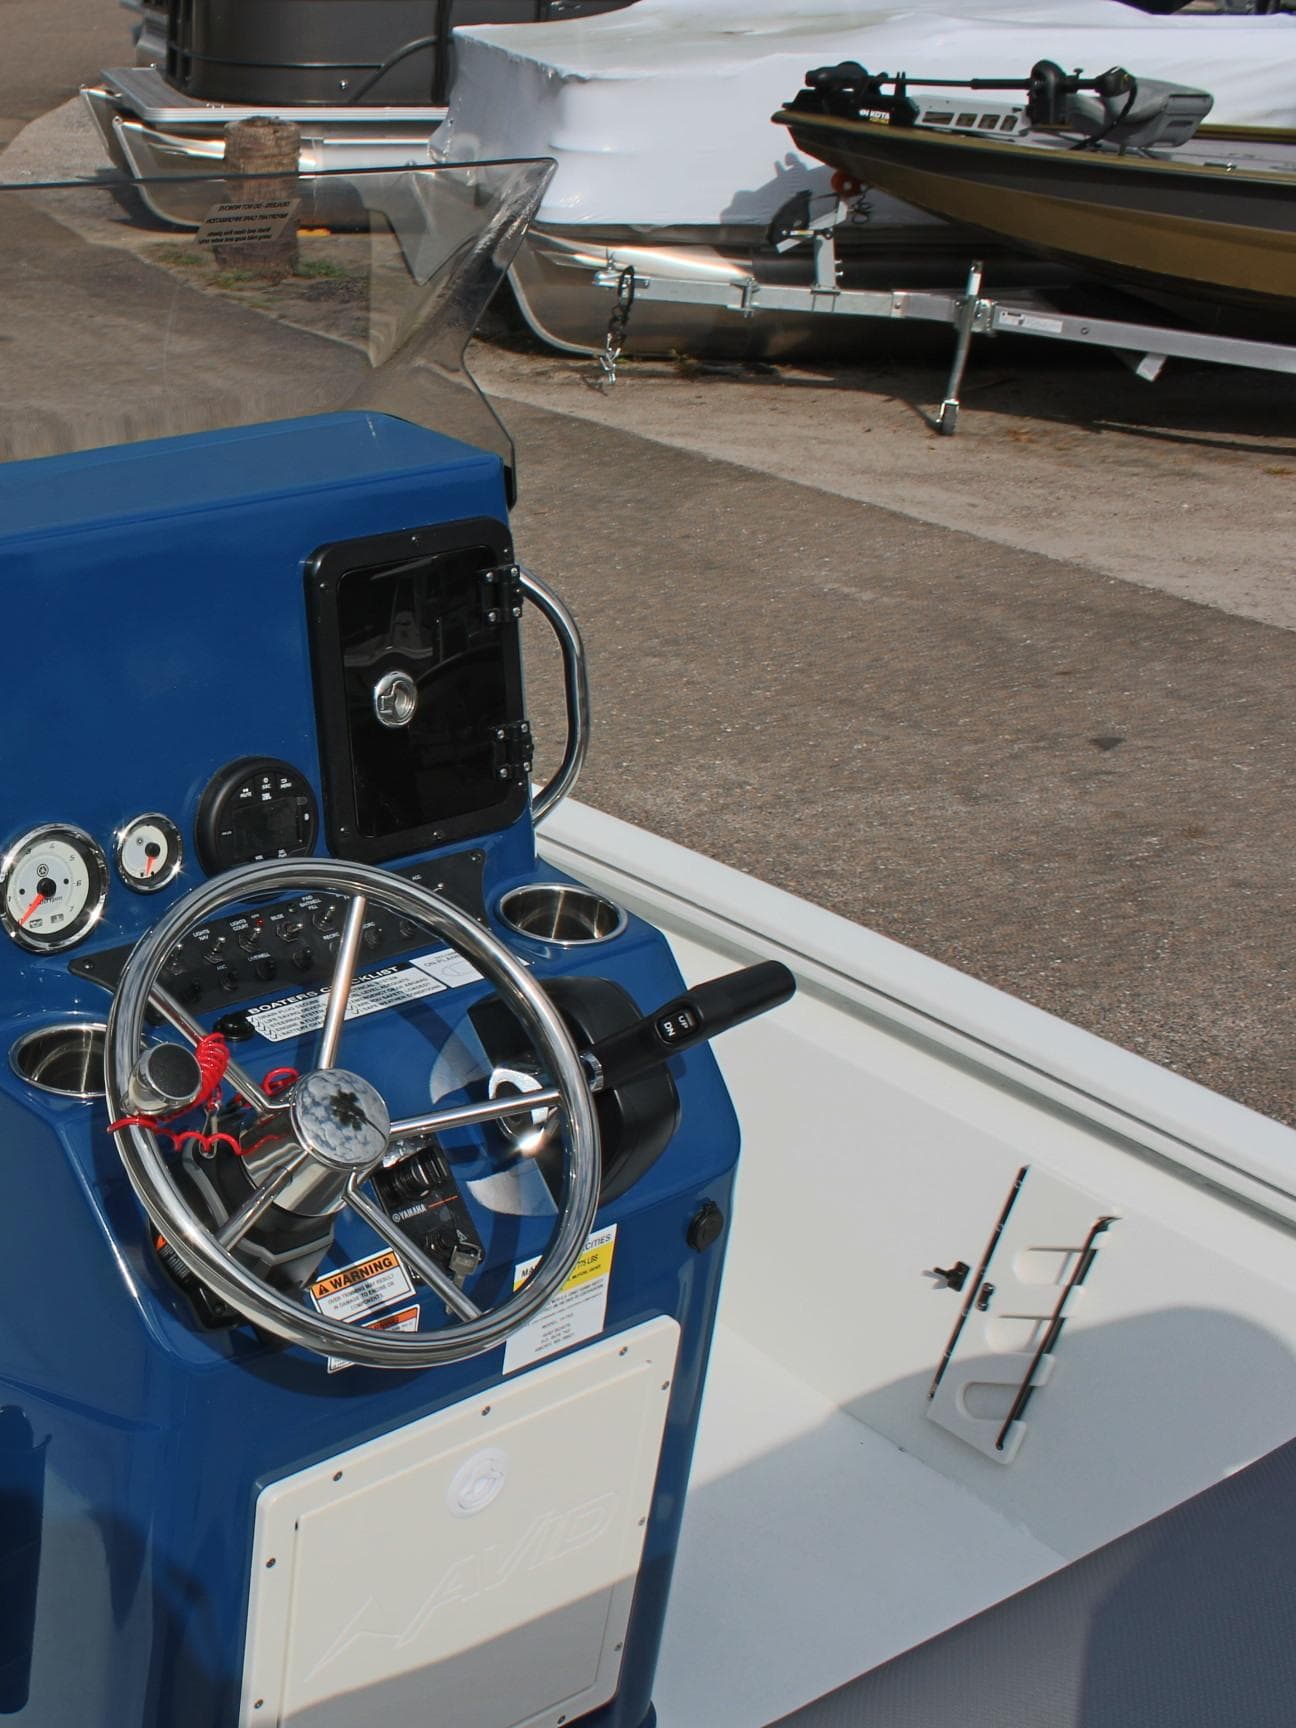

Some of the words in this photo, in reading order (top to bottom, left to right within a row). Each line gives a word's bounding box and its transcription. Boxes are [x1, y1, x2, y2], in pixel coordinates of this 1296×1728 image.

[248, 991, 318, 1014] BOATERS
[320, 966, 399, 993] CCKLIST
[664, 1021, 676, 1037] DN
[678, 1015, 689, 1029] UP
[399, 1204, 427, 1220] YAMAHA
[330, 1257, 393, 1290] WARNING
